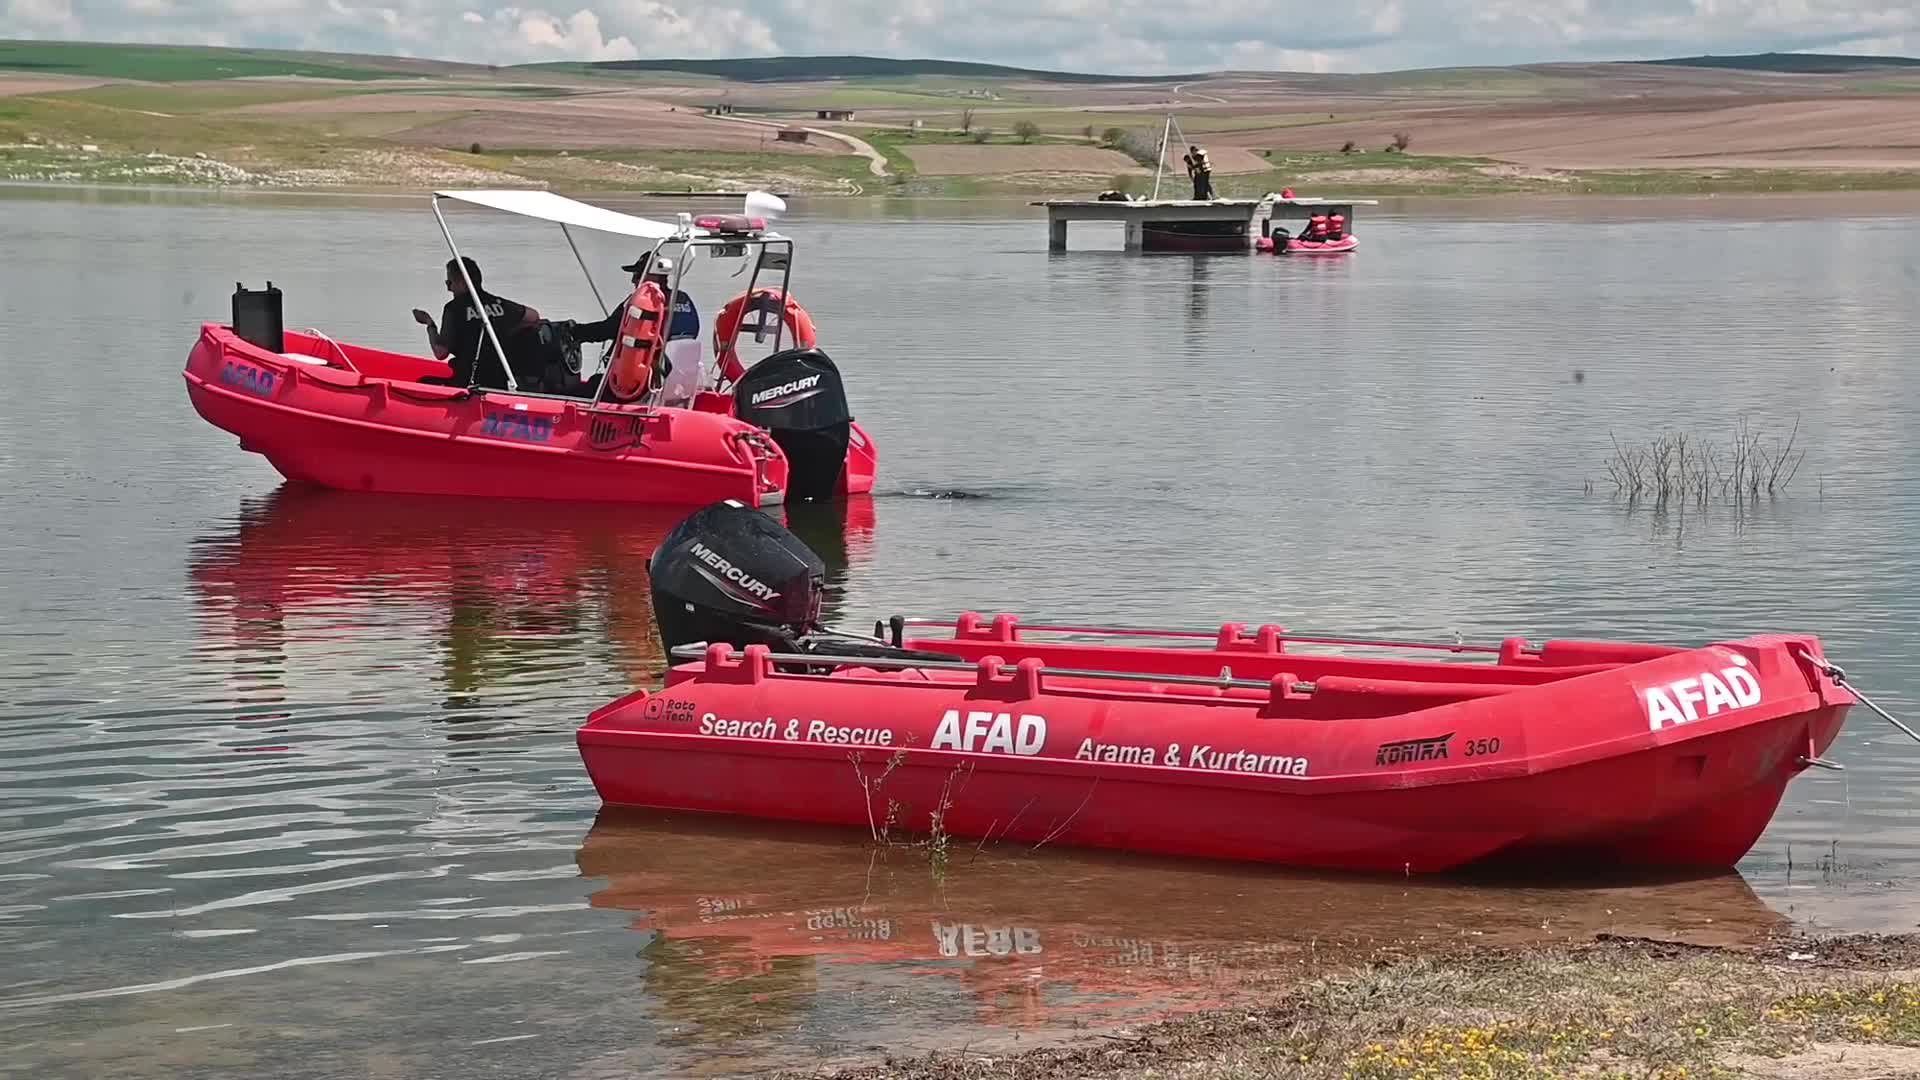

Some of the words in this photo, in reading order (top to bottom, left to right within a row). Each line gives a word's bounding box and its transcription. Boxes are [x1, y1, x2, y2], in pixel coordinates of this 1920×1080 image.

[467, 303, 505, 321] AAD
[222, 360, 274, 396] AFAD
[752, 374, 820, 404] MERCURY
[483, 411, 554, 441] AFAD
[690, 542, 782, 601] MERCURY
[666, 699, 696, 711] Roto
[1648, 665, 1762, 731] AFAD
[700, 712, 777, 740] Search
[783, 718, 800, 741] &
[807, 720, 893, 746] Rescue
[930, 709, 1048, 757] AFAD
[1076, 737, 1154, 765] Arama
[1164, 743, 1181, 767] &
[1188, 744, 1309, 776] Kurtarma
[1376, 734, 1452, 765] KONTRA
[1464, 737, 1500, 757] 350
